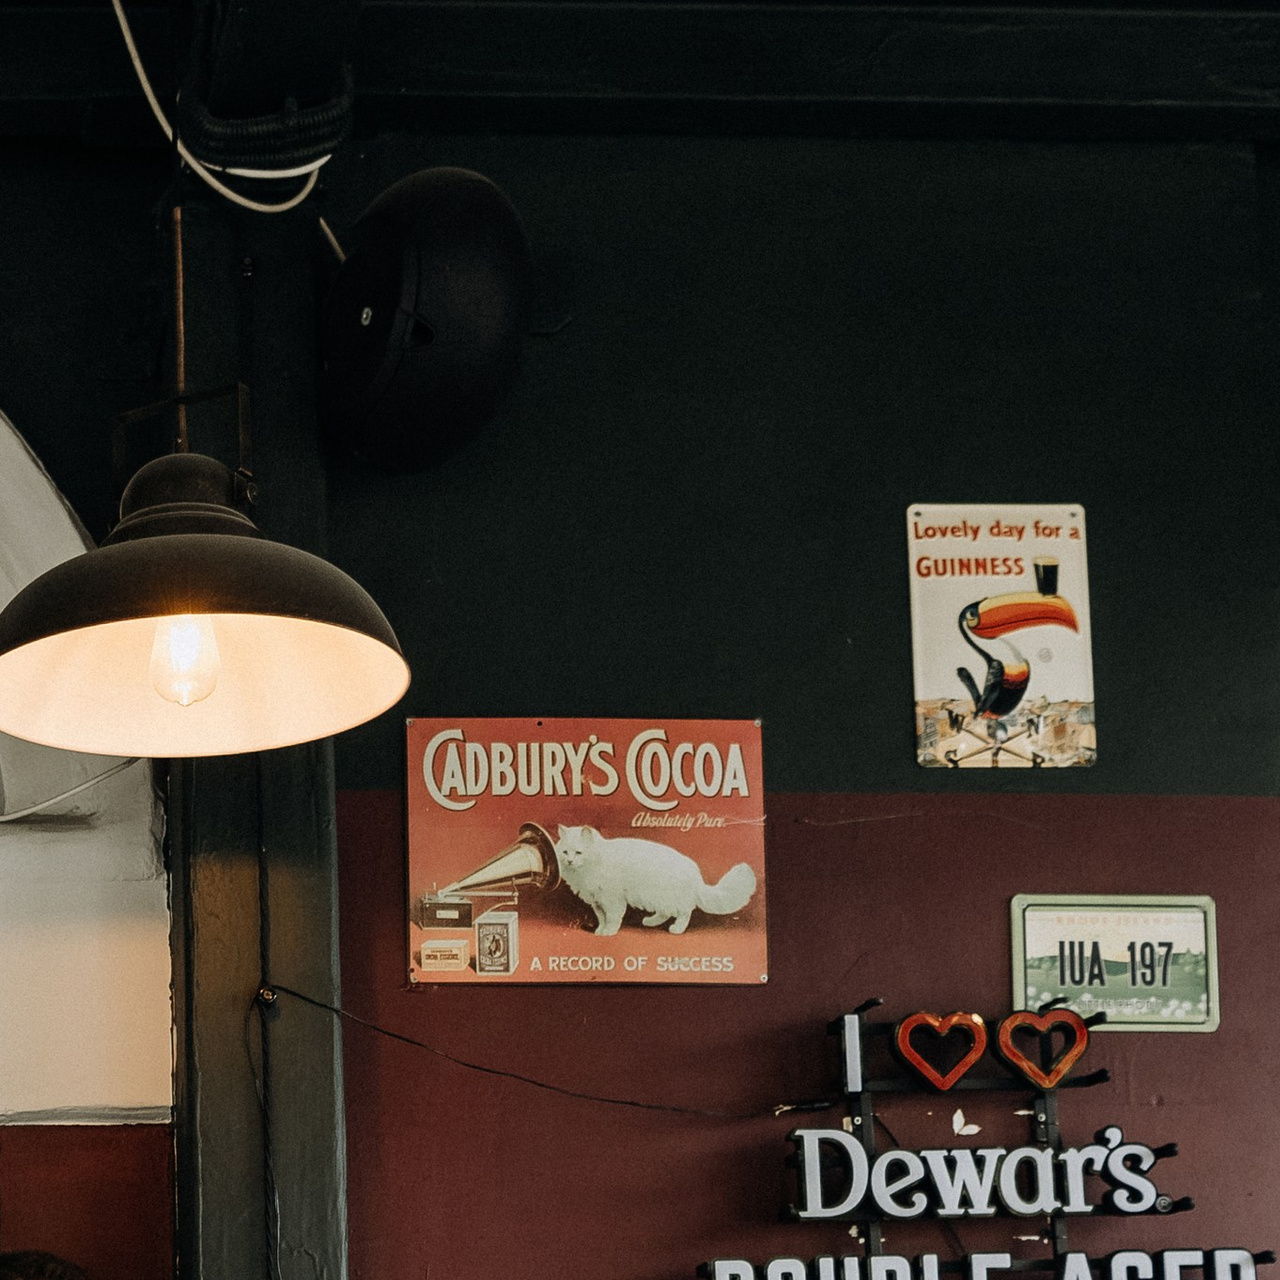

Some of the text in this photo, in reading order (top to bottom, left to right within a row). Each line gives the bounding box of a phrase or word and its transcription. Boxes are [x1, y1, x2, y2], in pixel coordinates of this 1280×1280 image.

[913, 519, 1081, 541] Lovely day for a
[916, 556, 1025, 578] GUINNESS
[423, 728, 750, 811] CADBURY'S COCOA
[631, 812, 693, 832] Absolutely
[530, 955, 735, 972] A RECORD OF SUCCESS
[1127, 941, 1173, 987] 197
[795, 1127, 1160, 1218] Dewar's
